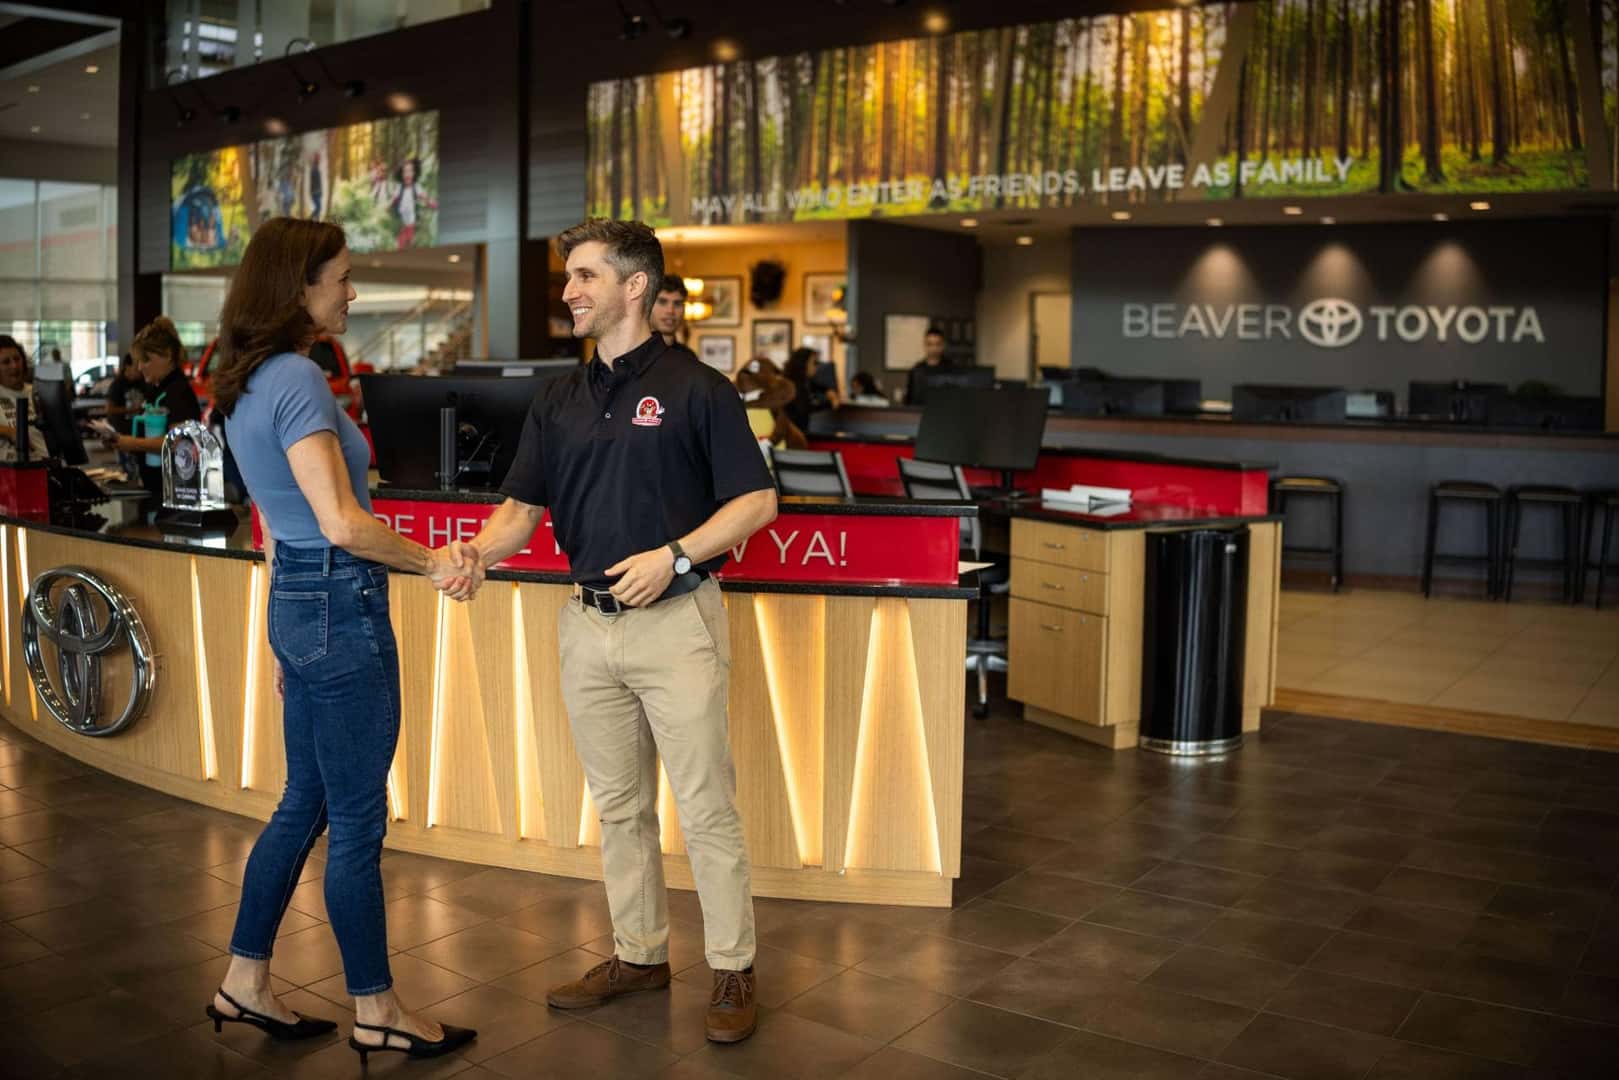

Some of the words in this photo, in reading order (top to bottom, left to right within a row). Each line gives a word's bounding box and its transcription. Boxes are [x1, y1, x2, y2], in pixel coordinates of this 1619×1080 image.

[691, 193, 737, 216] MAY
[785, 184, 841, 210] WHO
[848, 178, 924, 206] ENTER
[930, 175, 962, 202] AS
[1092, 163, 1185, 193] LEAVE
[1191, 160, 1232, 187] AS
[1239, 156, 1354, 186] FAMILY
[1122, 302, 1292, 340] BEAVER
[1370, 306, 1546, 343] TOYOTA
[768, 528, 849, 567] YA!
